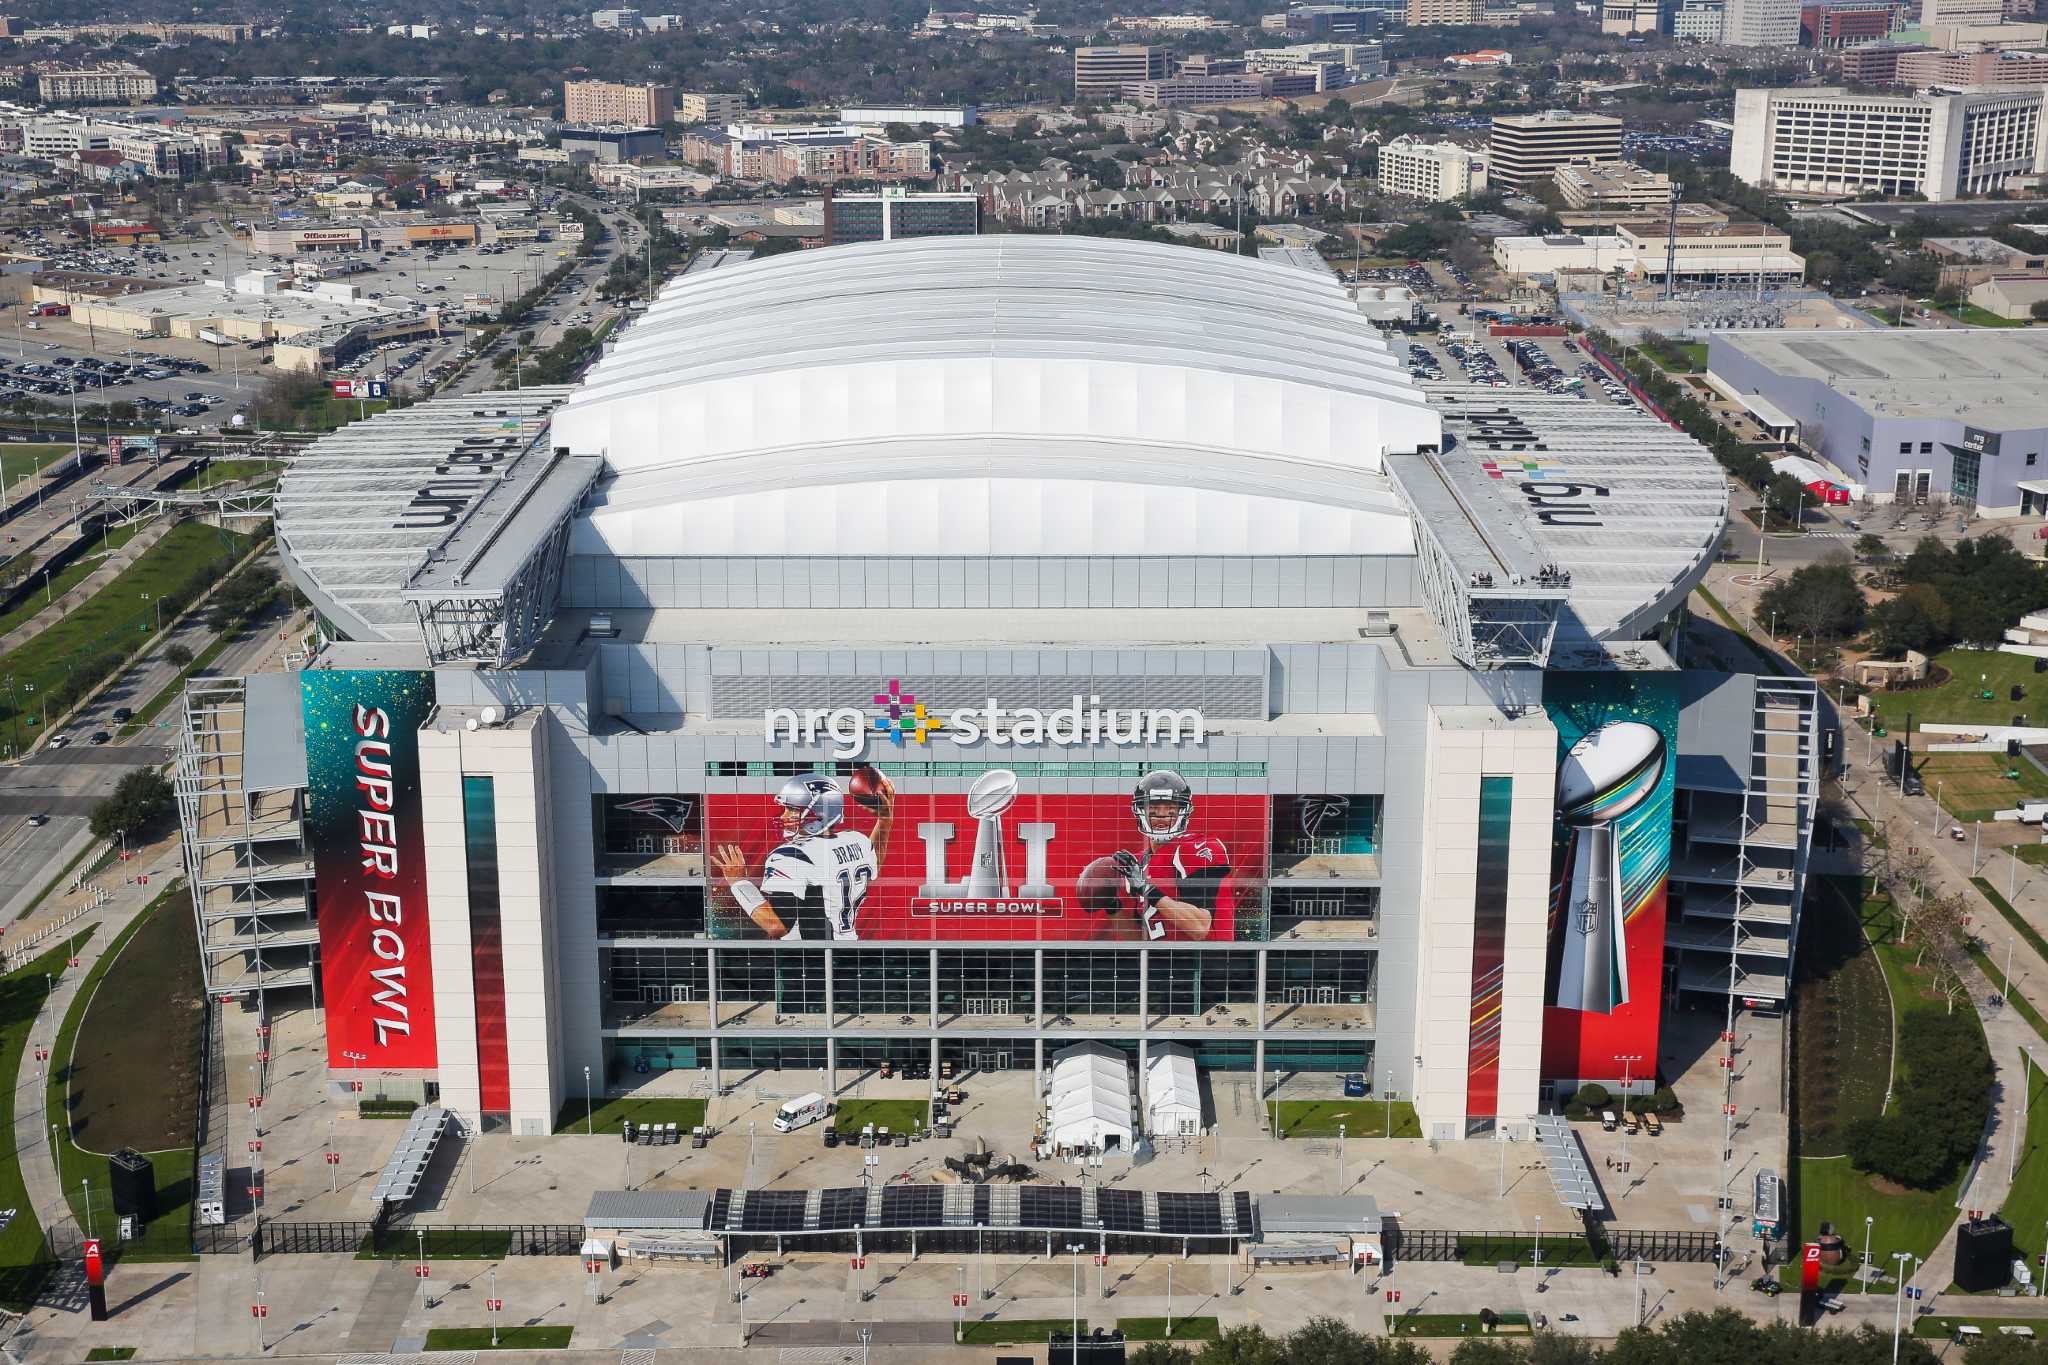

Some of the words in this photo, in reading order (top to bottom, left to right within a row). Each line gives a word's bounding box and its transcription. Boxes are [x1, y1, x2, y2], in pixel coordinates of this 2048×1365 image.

[764, 706, 866, 760] nrg
[950, 694, 1206, 745] stadium
[352, 703, 399, 880] SUPER
[832, 843, 864, 865] BRADY
[928, 902, 988, 913] SUPER
[996, 902, 1046, 913] BOWL
[364, 890, 411, 1048] BOWL
[87, 1244, 98, 1254] A
[1807, 1248, 1820, 1258] D
